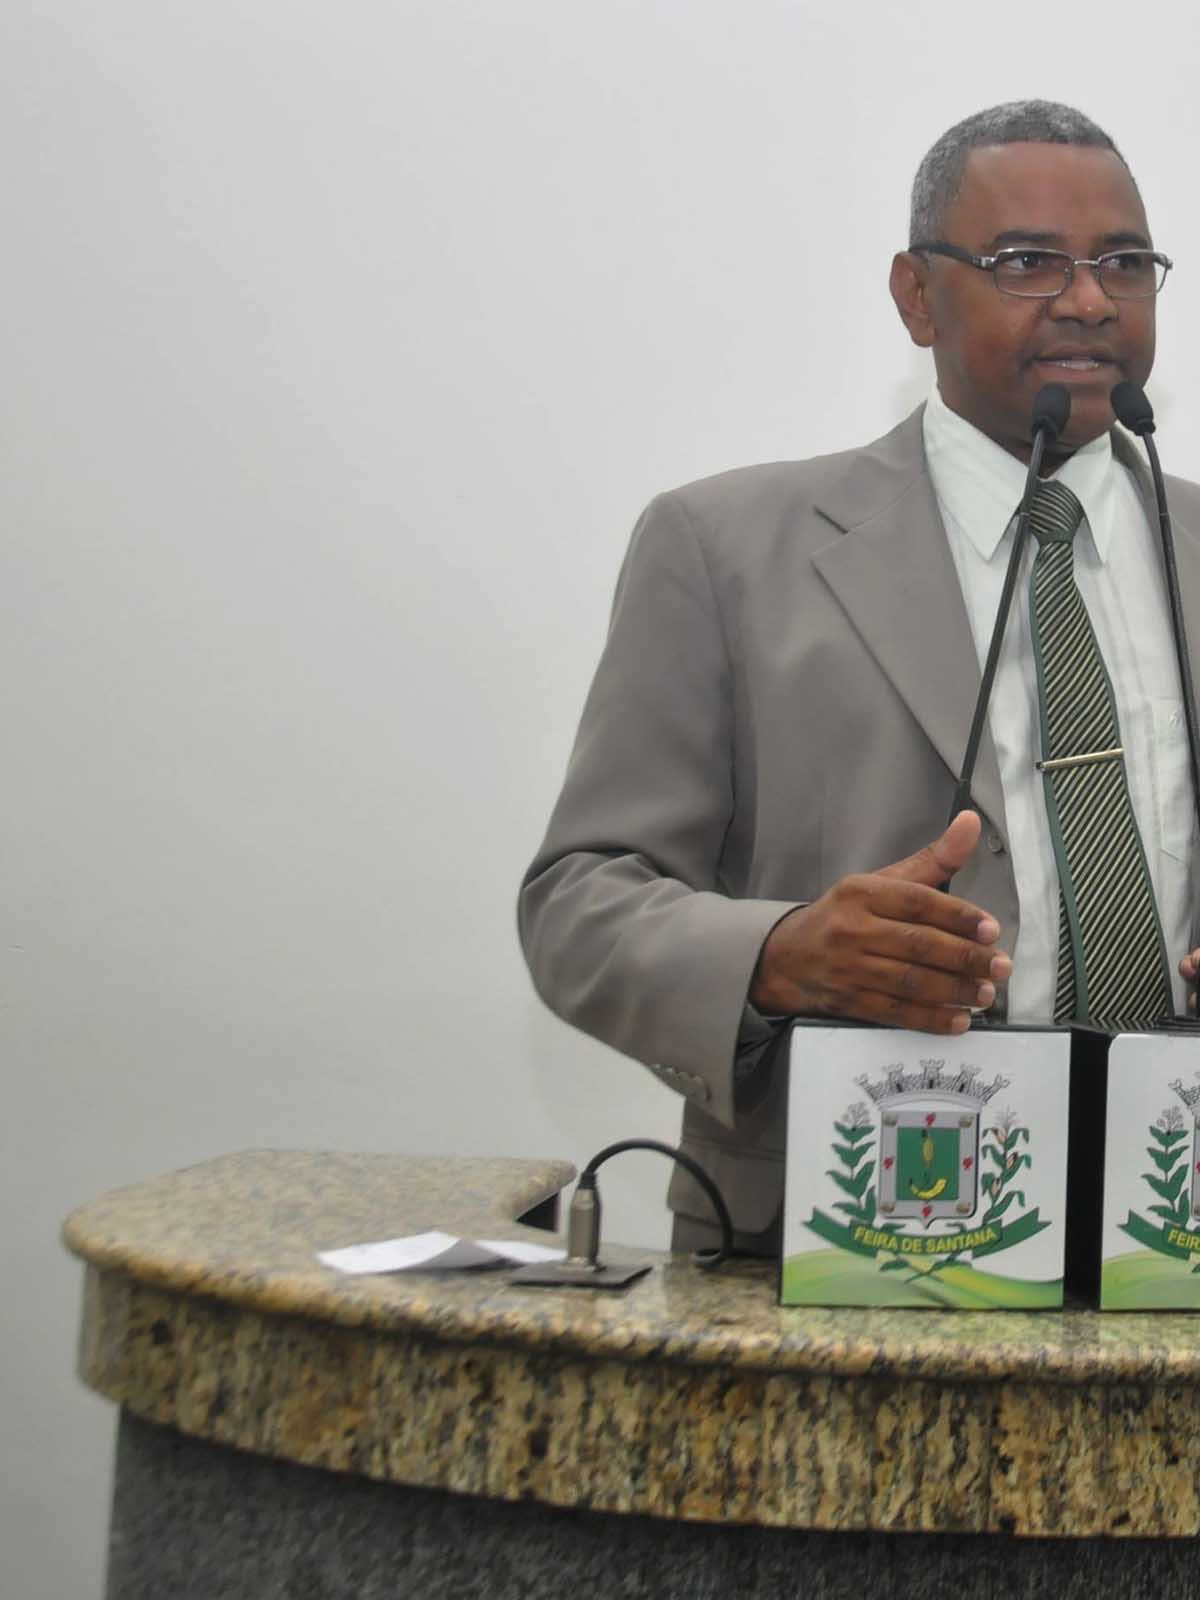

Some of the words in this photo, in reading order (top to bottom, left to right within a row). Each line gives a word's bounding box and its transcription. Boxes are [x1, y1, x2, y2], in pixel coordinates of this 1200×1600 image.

[854, 1227, 898, 1249] FEIRA
[901, 1239, 922, 1253] DE
[926, 1227, 997, 1253] SANTANA
